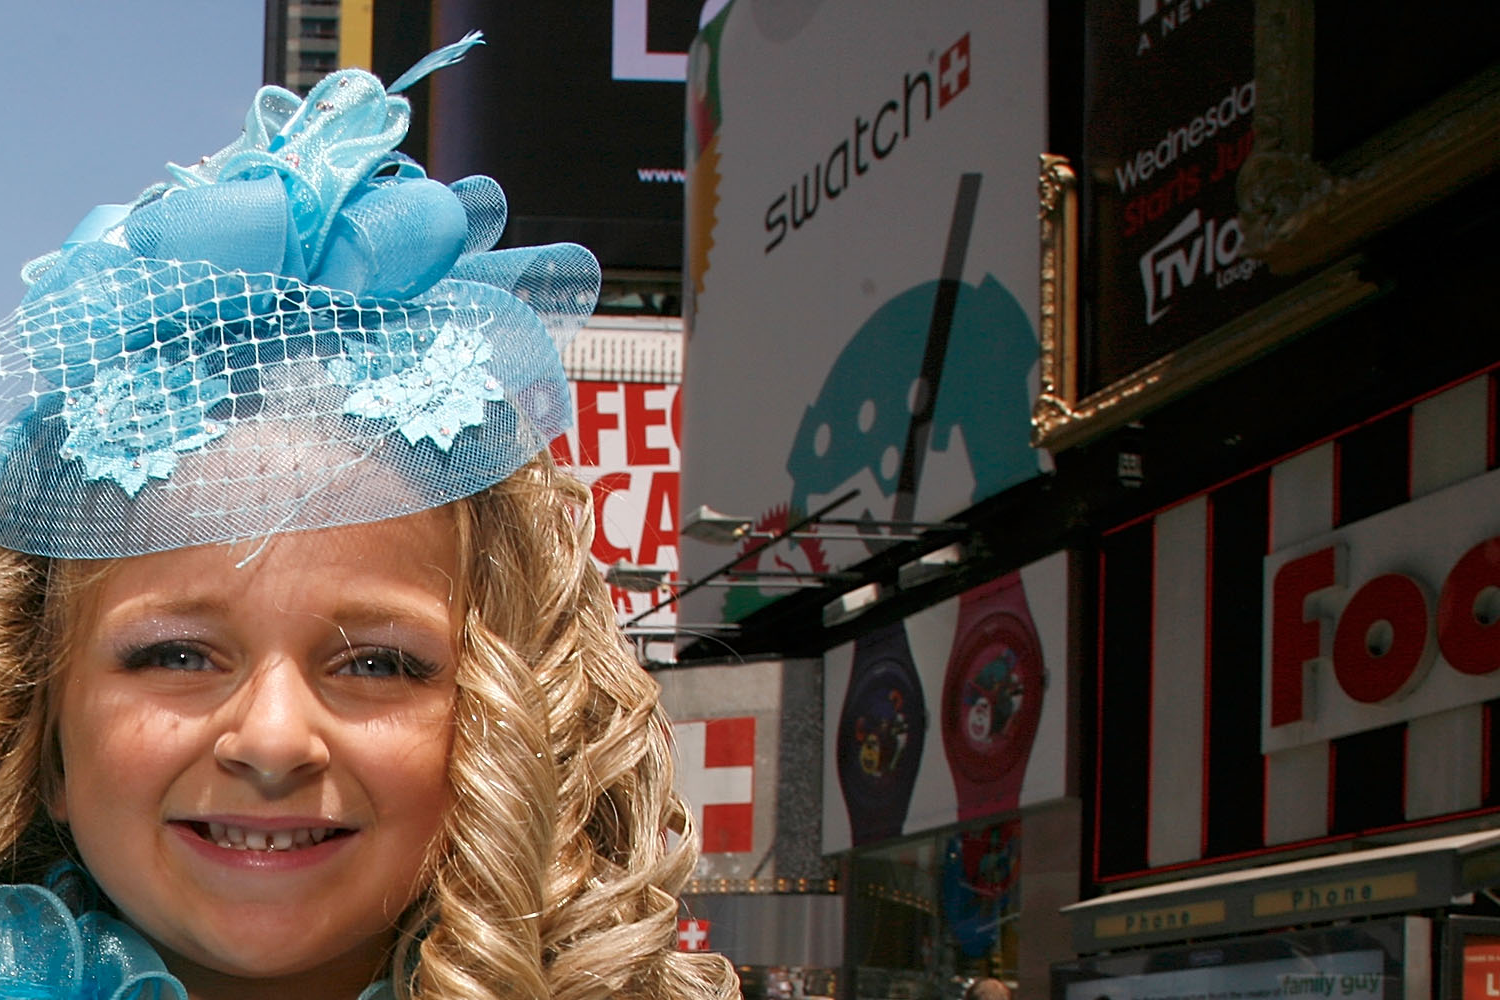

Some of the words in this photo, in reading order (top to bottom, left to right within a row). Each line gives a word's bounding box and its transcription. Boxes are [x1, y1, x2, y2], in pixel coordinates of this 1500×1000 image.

[1114, 80, 1256, 194] Wednesda
[1292, 882, 1373, 910] Phone
[1124, 910, 1192, 932] Phone
[1340, 974, 1381, 997] guy
